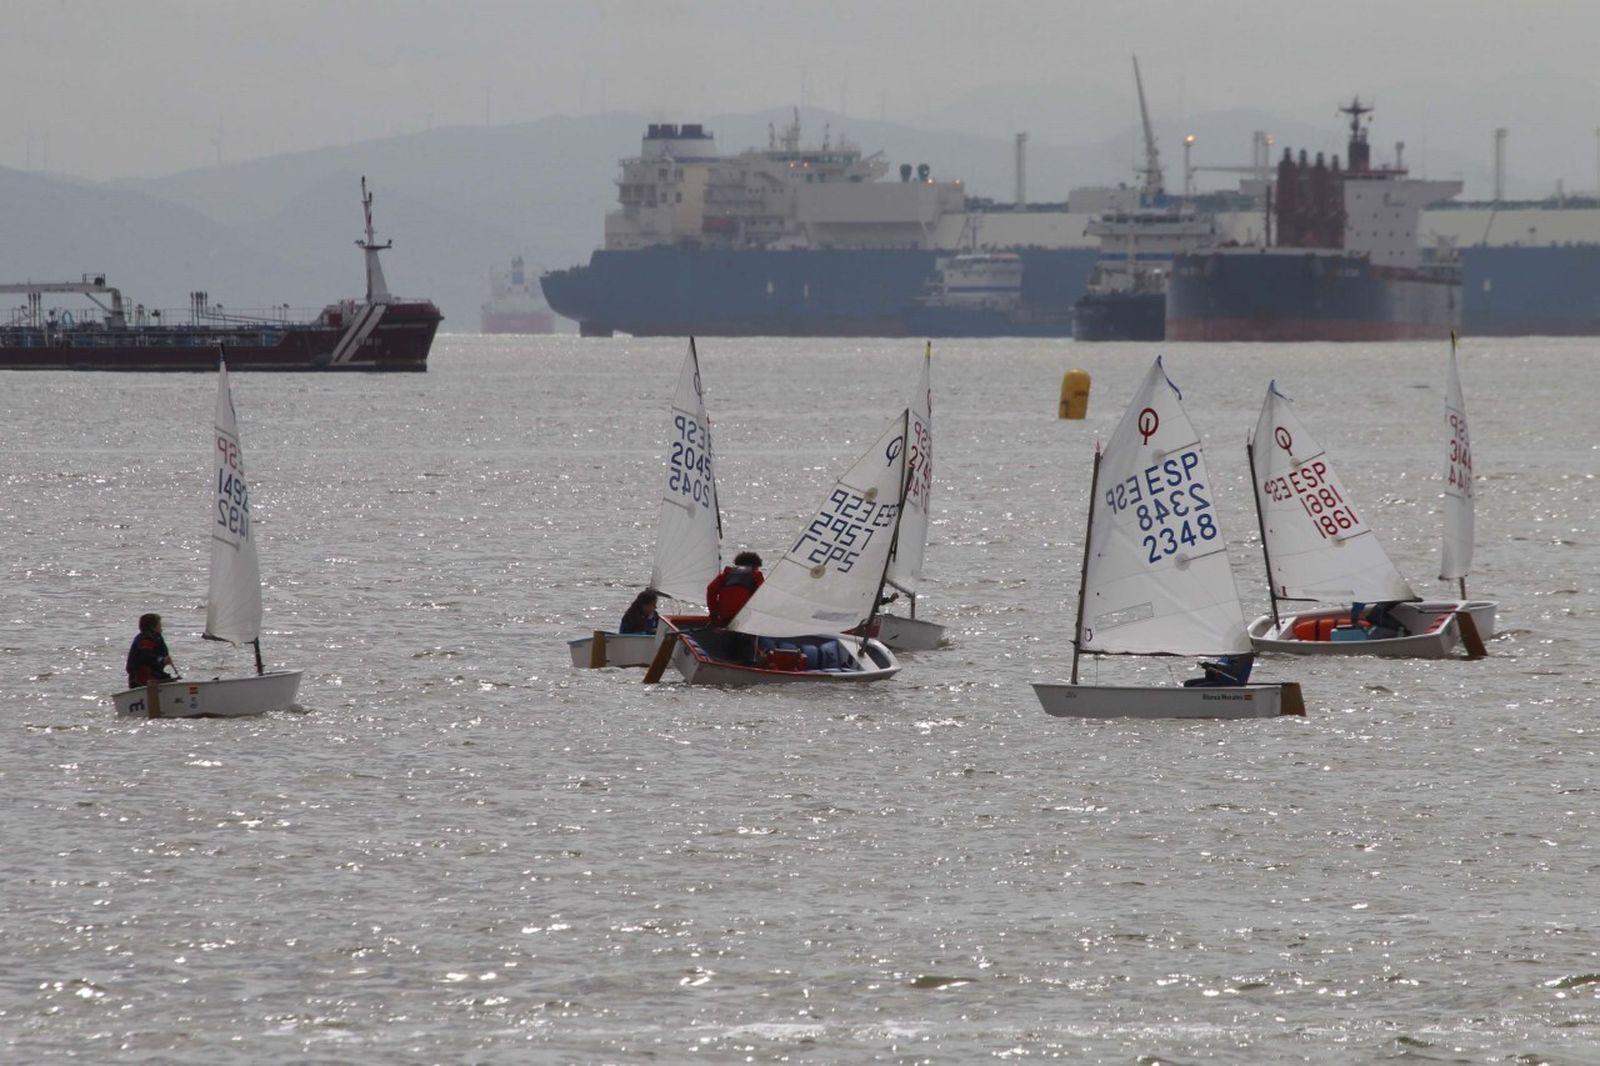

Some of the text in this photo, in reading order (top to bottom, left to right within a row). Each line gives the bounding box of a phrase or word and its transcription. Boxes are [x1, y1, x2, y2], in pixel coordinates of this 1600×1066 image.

[671, 441, 711, 481] 2045
[1145, 452, 1198, 495] ESP
[1289, 462, 1326, 494] ESP
[809, 512, 874, 551] 2957
[1143, 513, 1217, 563] 2348
[1313, 506, 1358, 539] 1861
